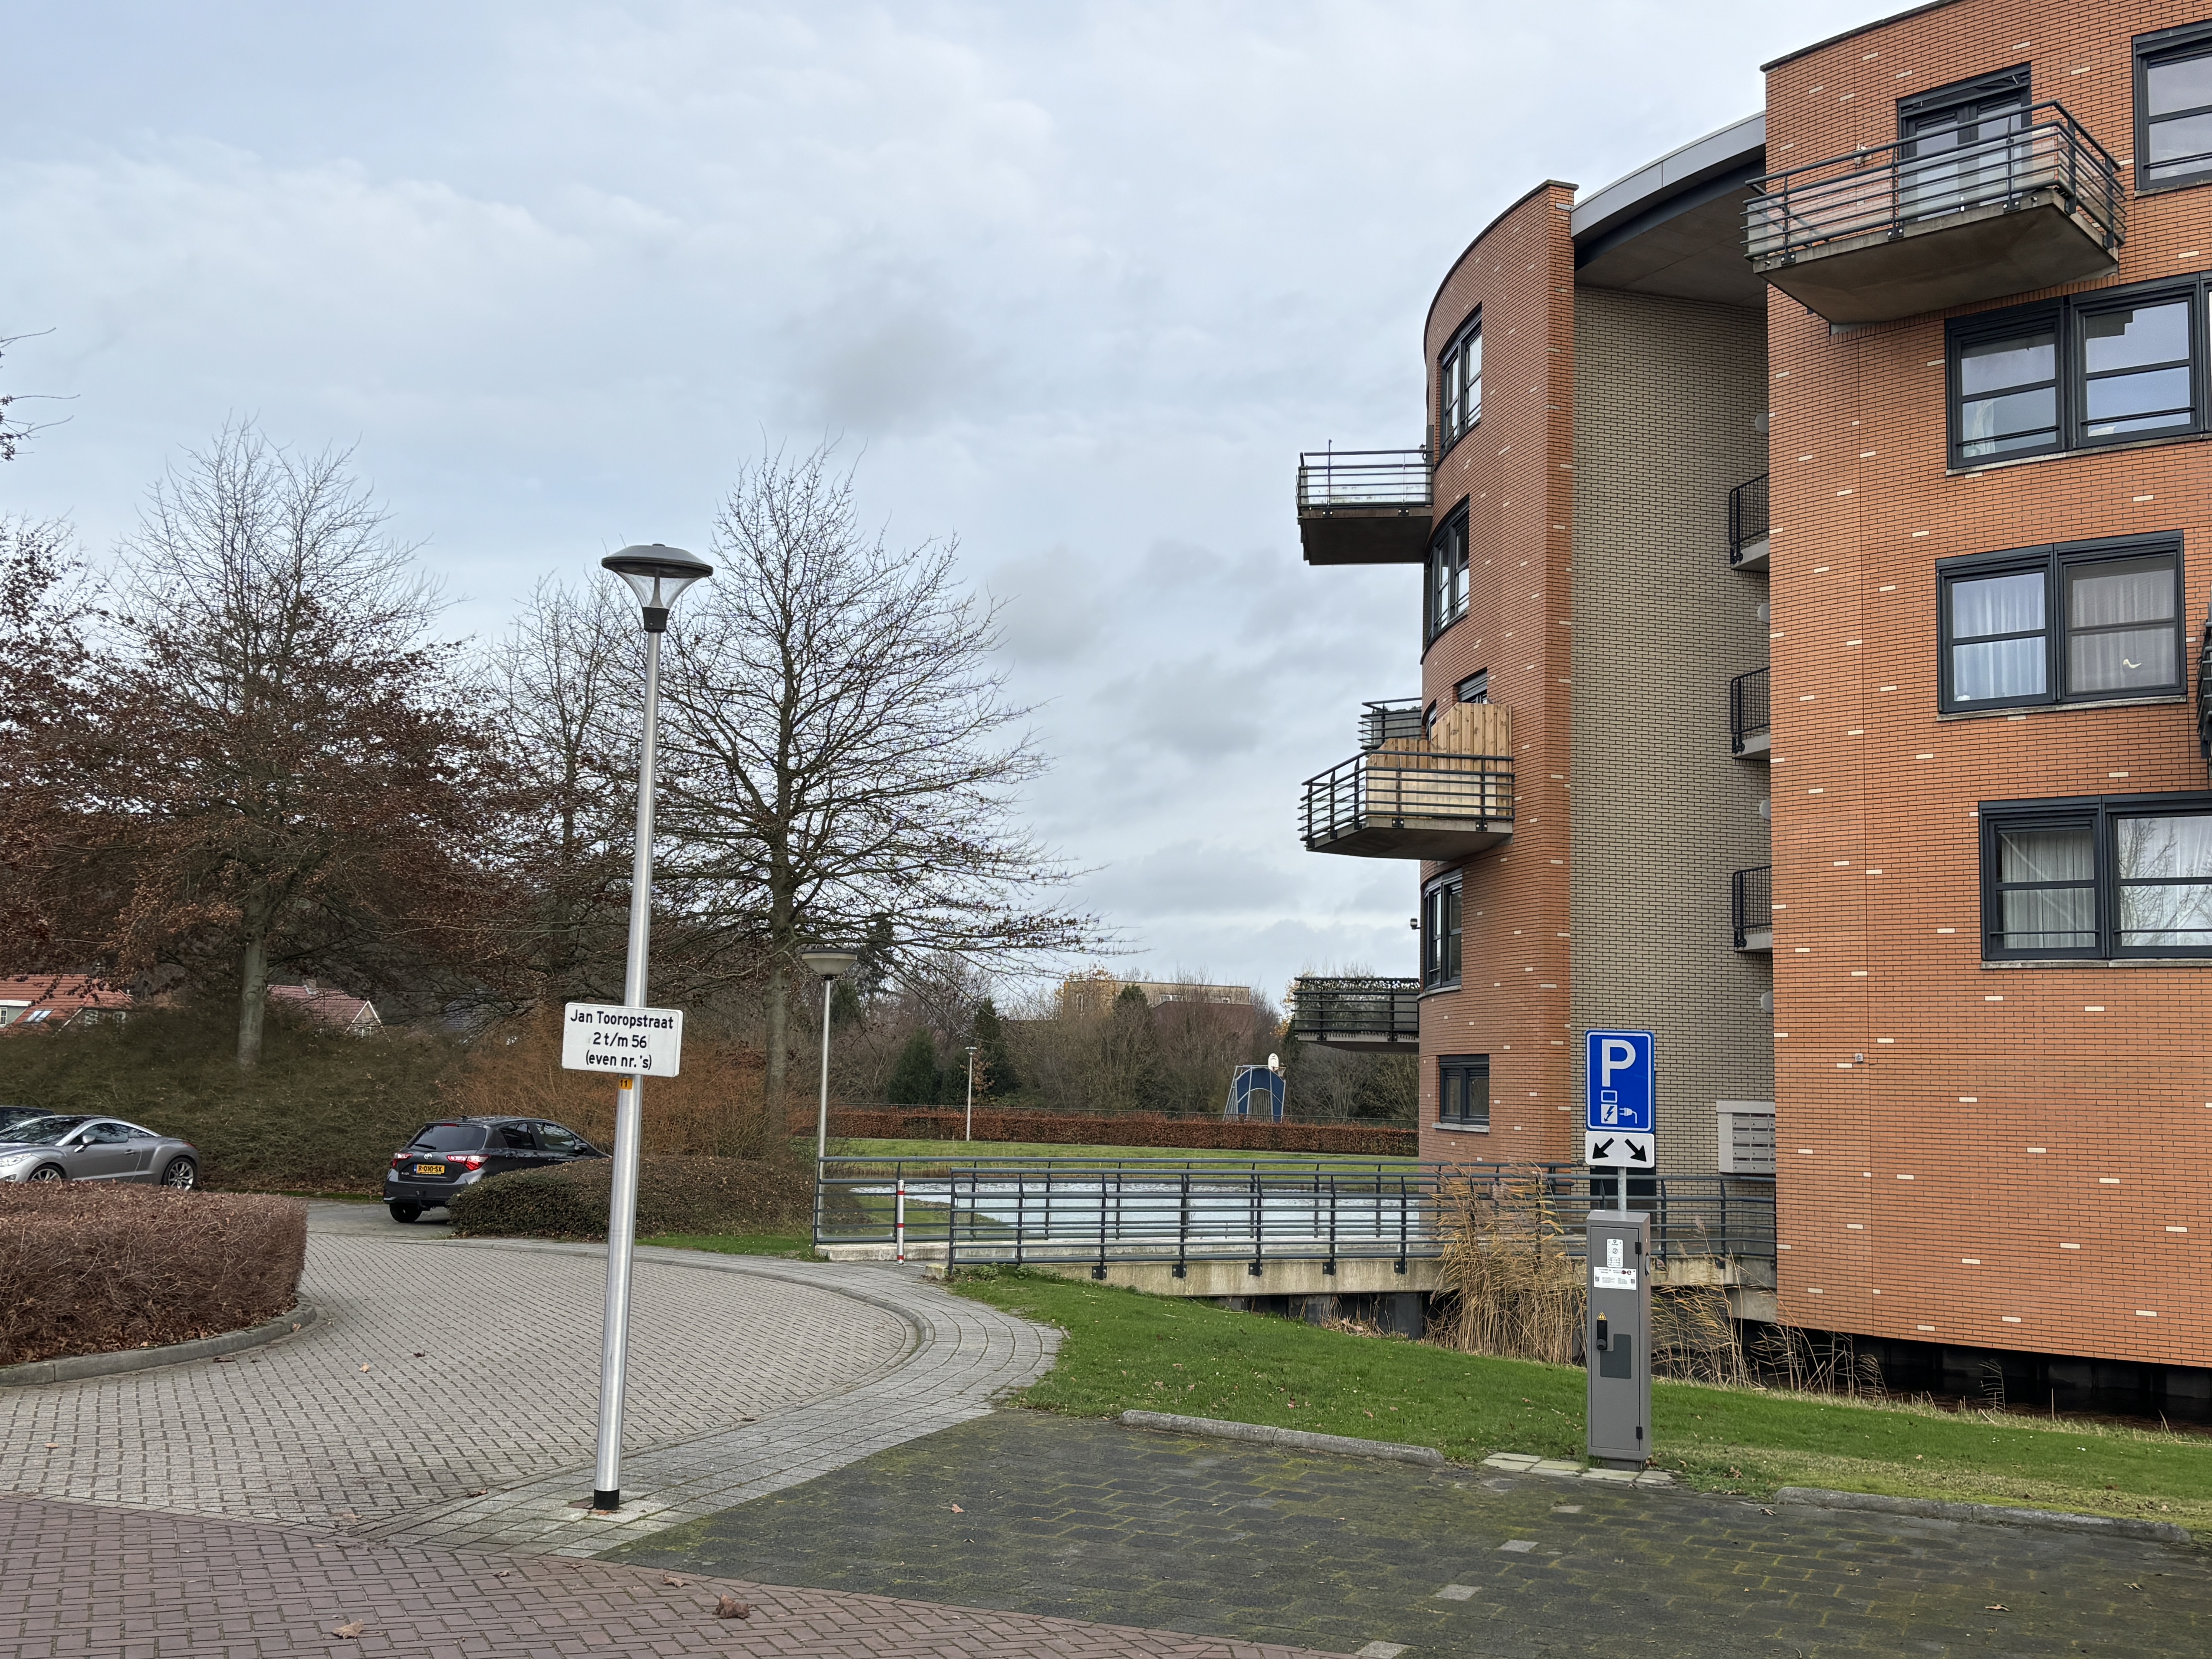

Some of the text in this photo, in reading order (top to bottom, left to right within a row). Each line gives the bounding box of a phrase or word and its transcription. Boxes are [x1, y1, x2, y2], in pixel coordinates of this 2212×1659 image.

[570, 1009, 673, 1029] Jan Tooropstraat
[593, 1032, 647, 1048] 2 t/m 56
[586, 1049, 617, 1066] (even
[1602, 1039, 1636, 1087] P
[620, 1079, 627, 1087] 11
